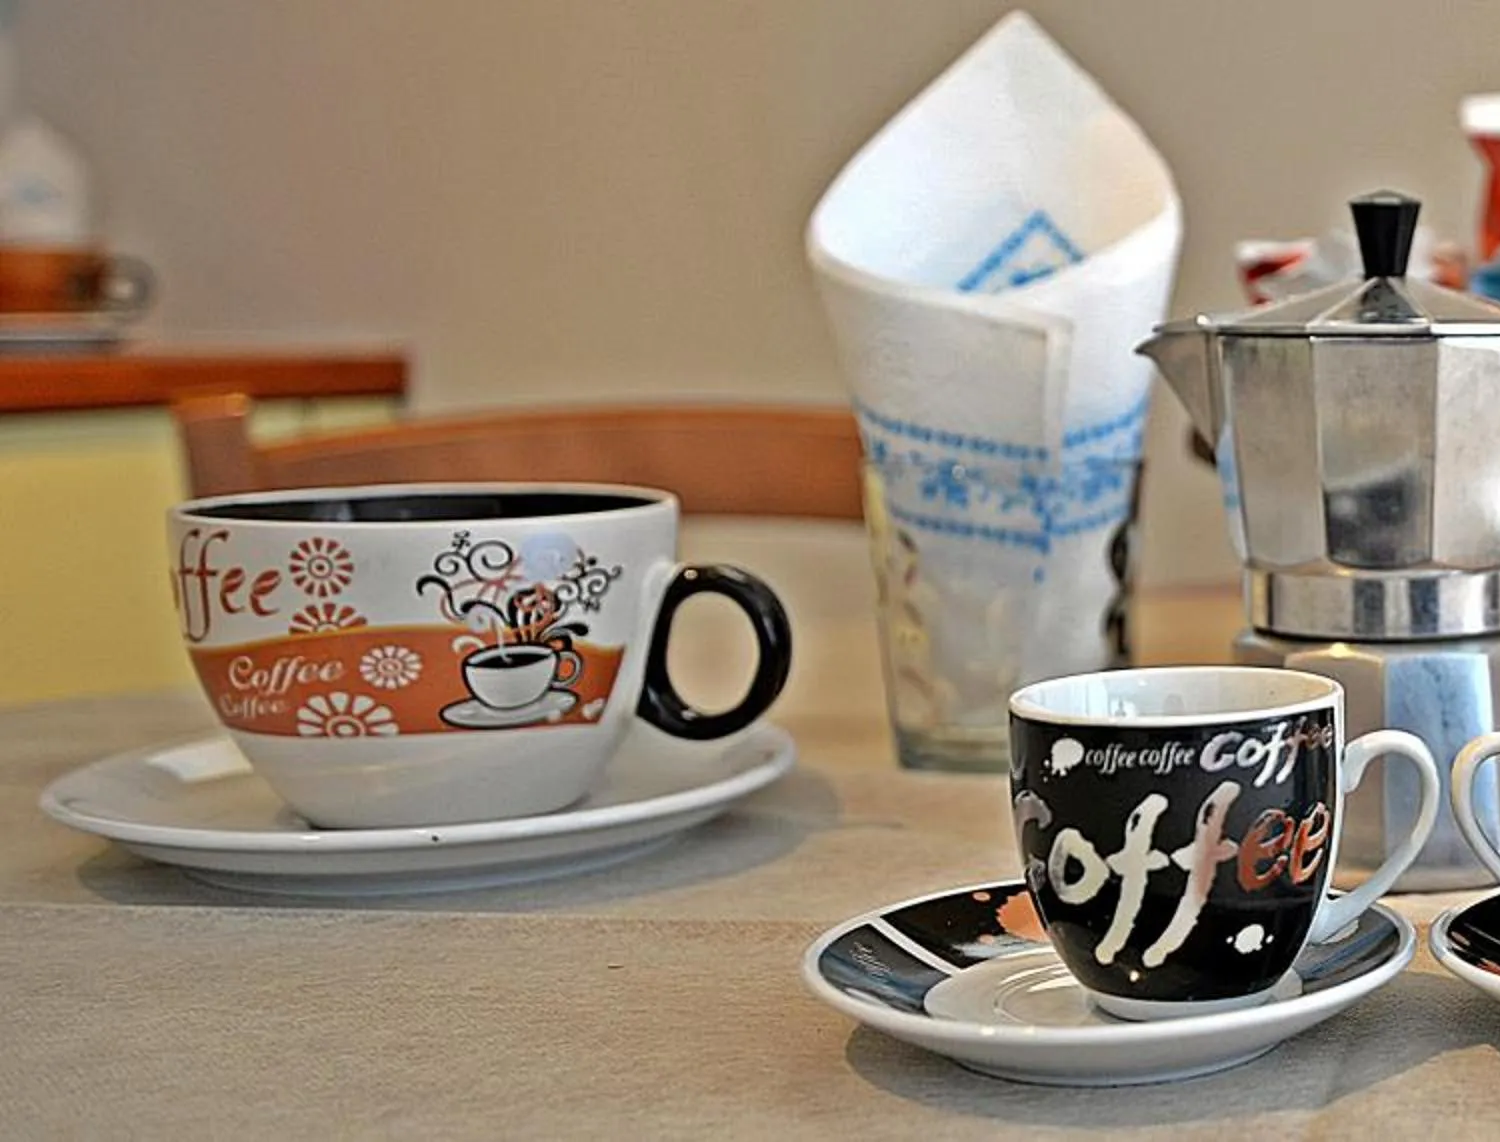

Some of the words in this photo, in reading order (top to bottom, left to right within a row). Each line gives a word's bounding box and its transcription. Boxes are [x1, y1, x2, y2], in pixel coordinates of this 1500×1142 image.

[228, 655, 345, 695] Coffee
[1085, 742, 1137, 774] coffee
[1139, 741, 1196, 774] coffee
